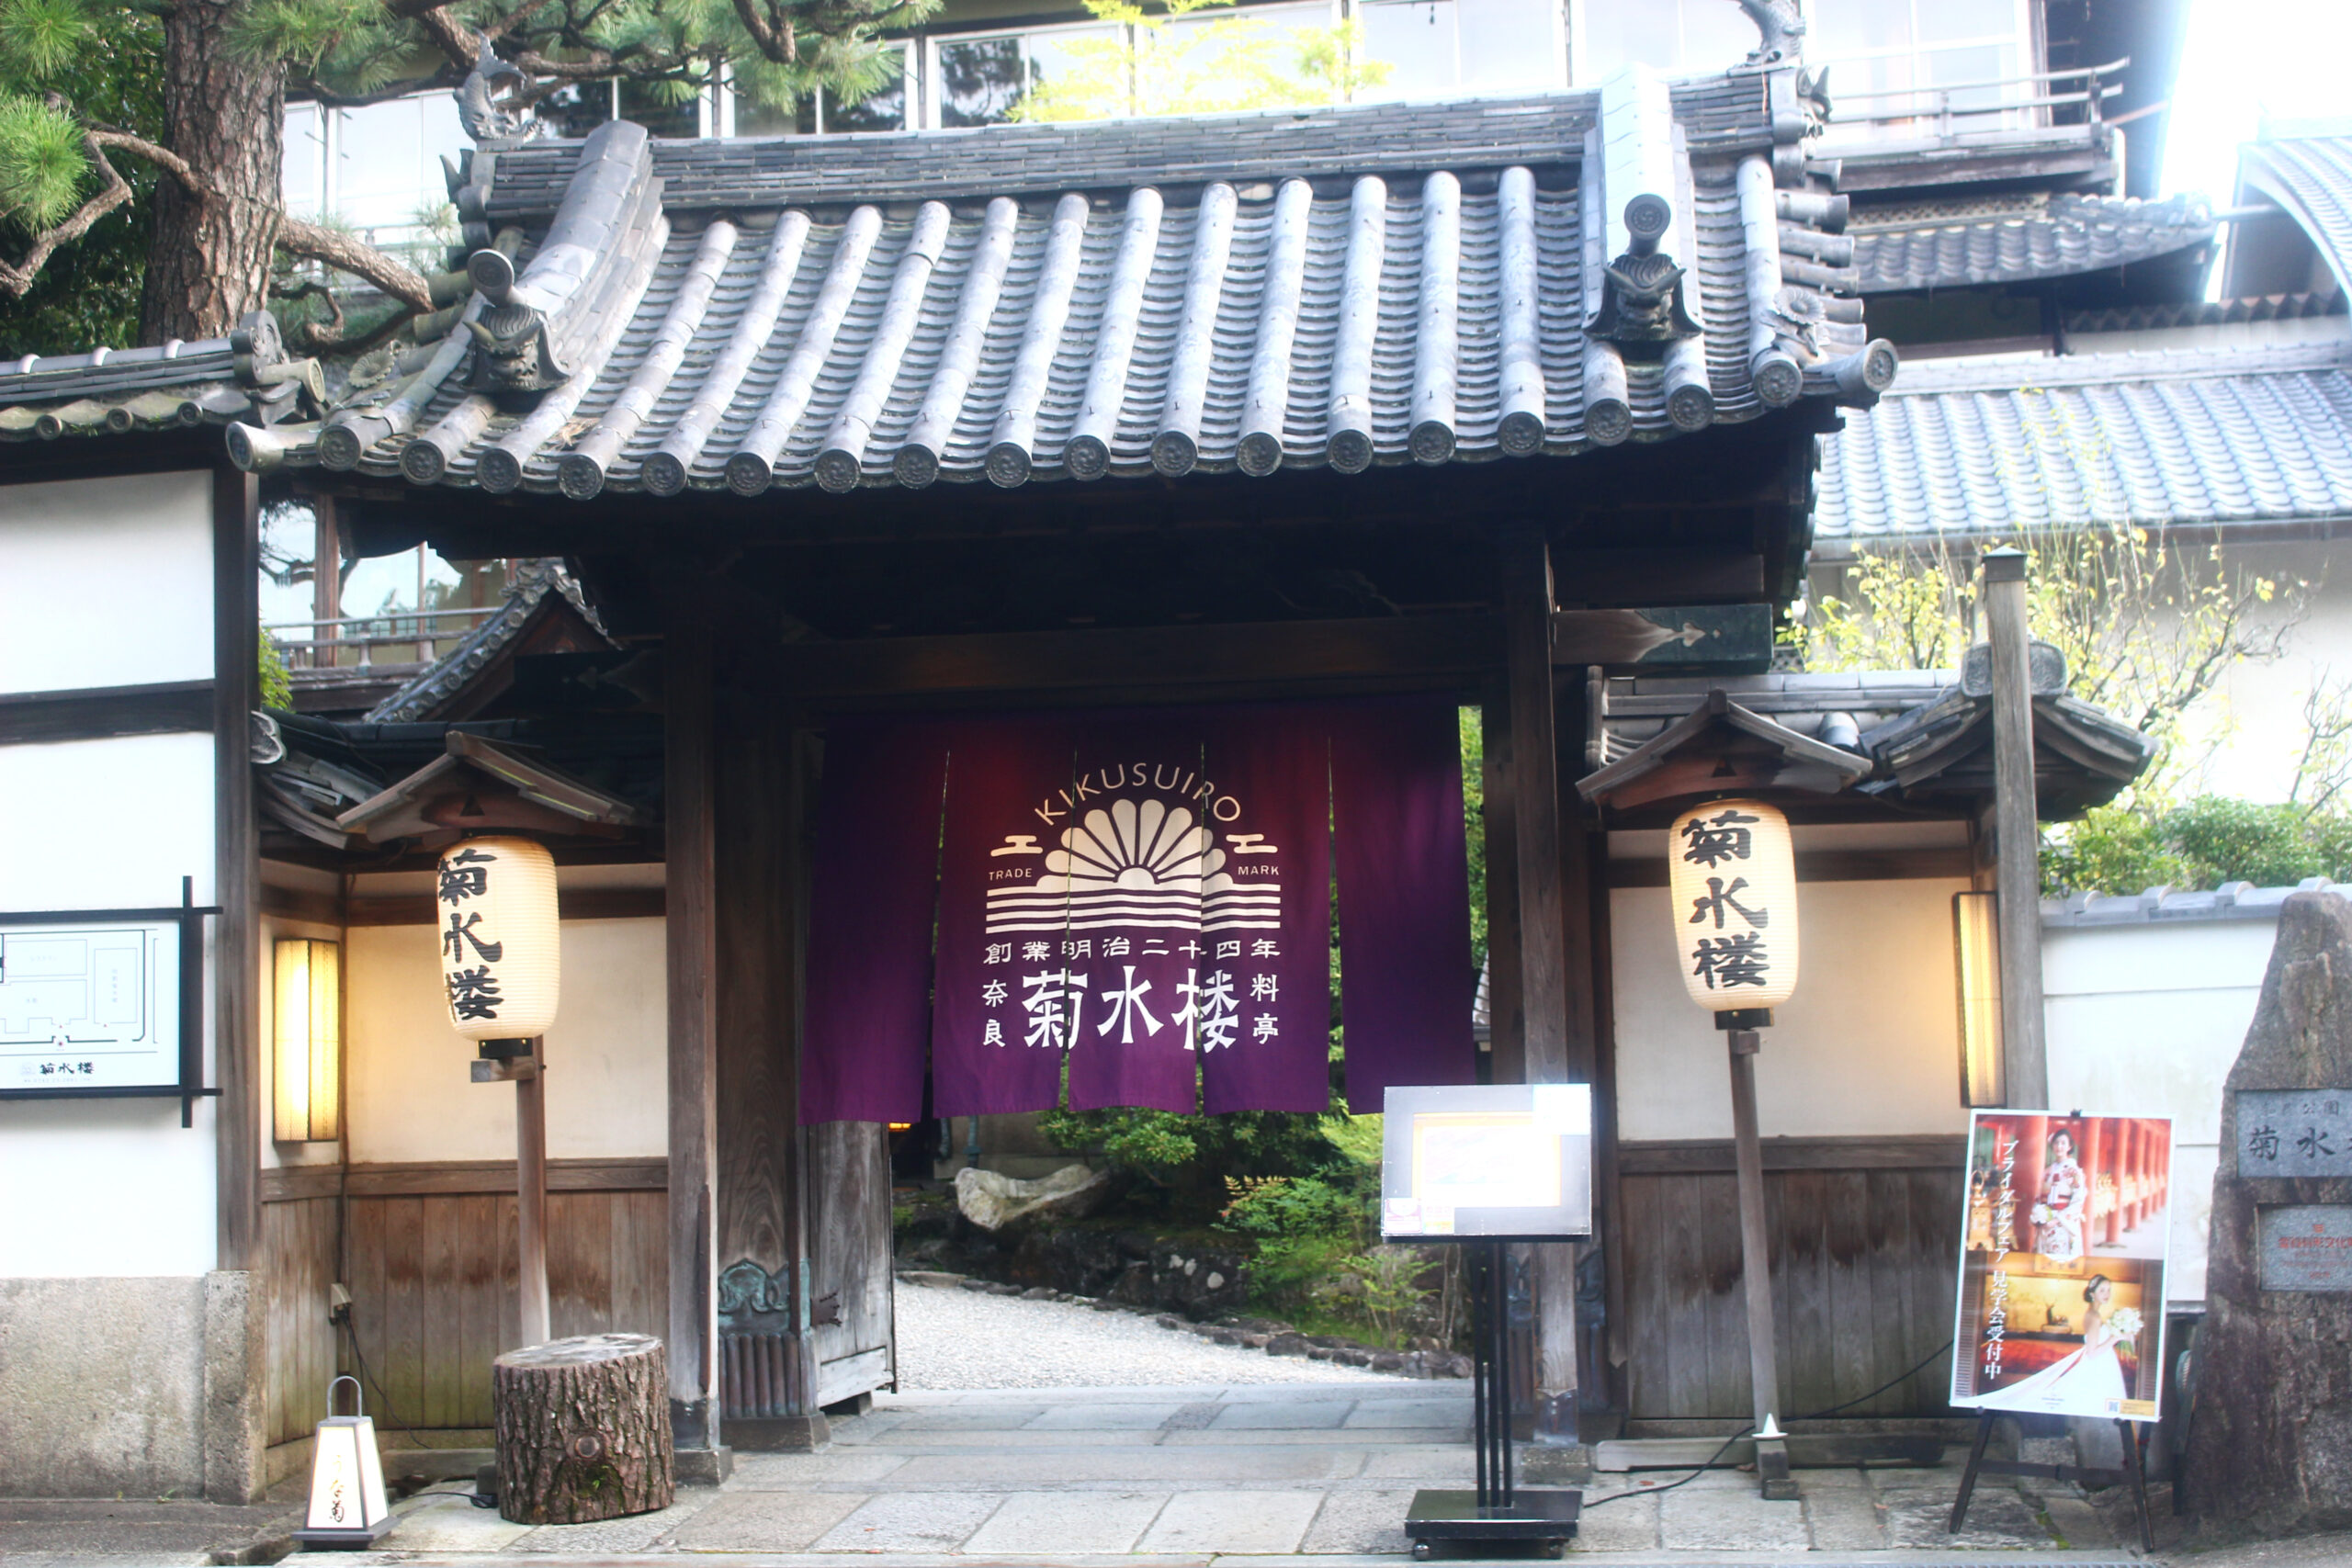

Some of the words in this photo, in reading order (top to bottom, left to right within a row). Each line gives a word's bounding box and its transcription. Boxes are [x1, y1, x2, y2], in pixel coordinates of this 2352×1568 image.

[1035, 762, 1240, 826] KIKUSUIRO
[989, 867, 1033, 881] TRADE
[1238, 865, 1280, 875] MARK
[1680, 810, 1770, 990] 菊水楼
[983, 935, 1281, 965] 創業明治二十四年
[982, 979, 1009, 1048] 奈良
[1022, 965, 1240, 1054] 菊水楼
[1250, 974, 1280, 1044] 料亭
[2247, 1124, 2352, 1161] 菊水
[1995, 1140, 2019, 1262] ブライダルフェア
[1984, 1270, 2008, 1380] 見学会受付中
